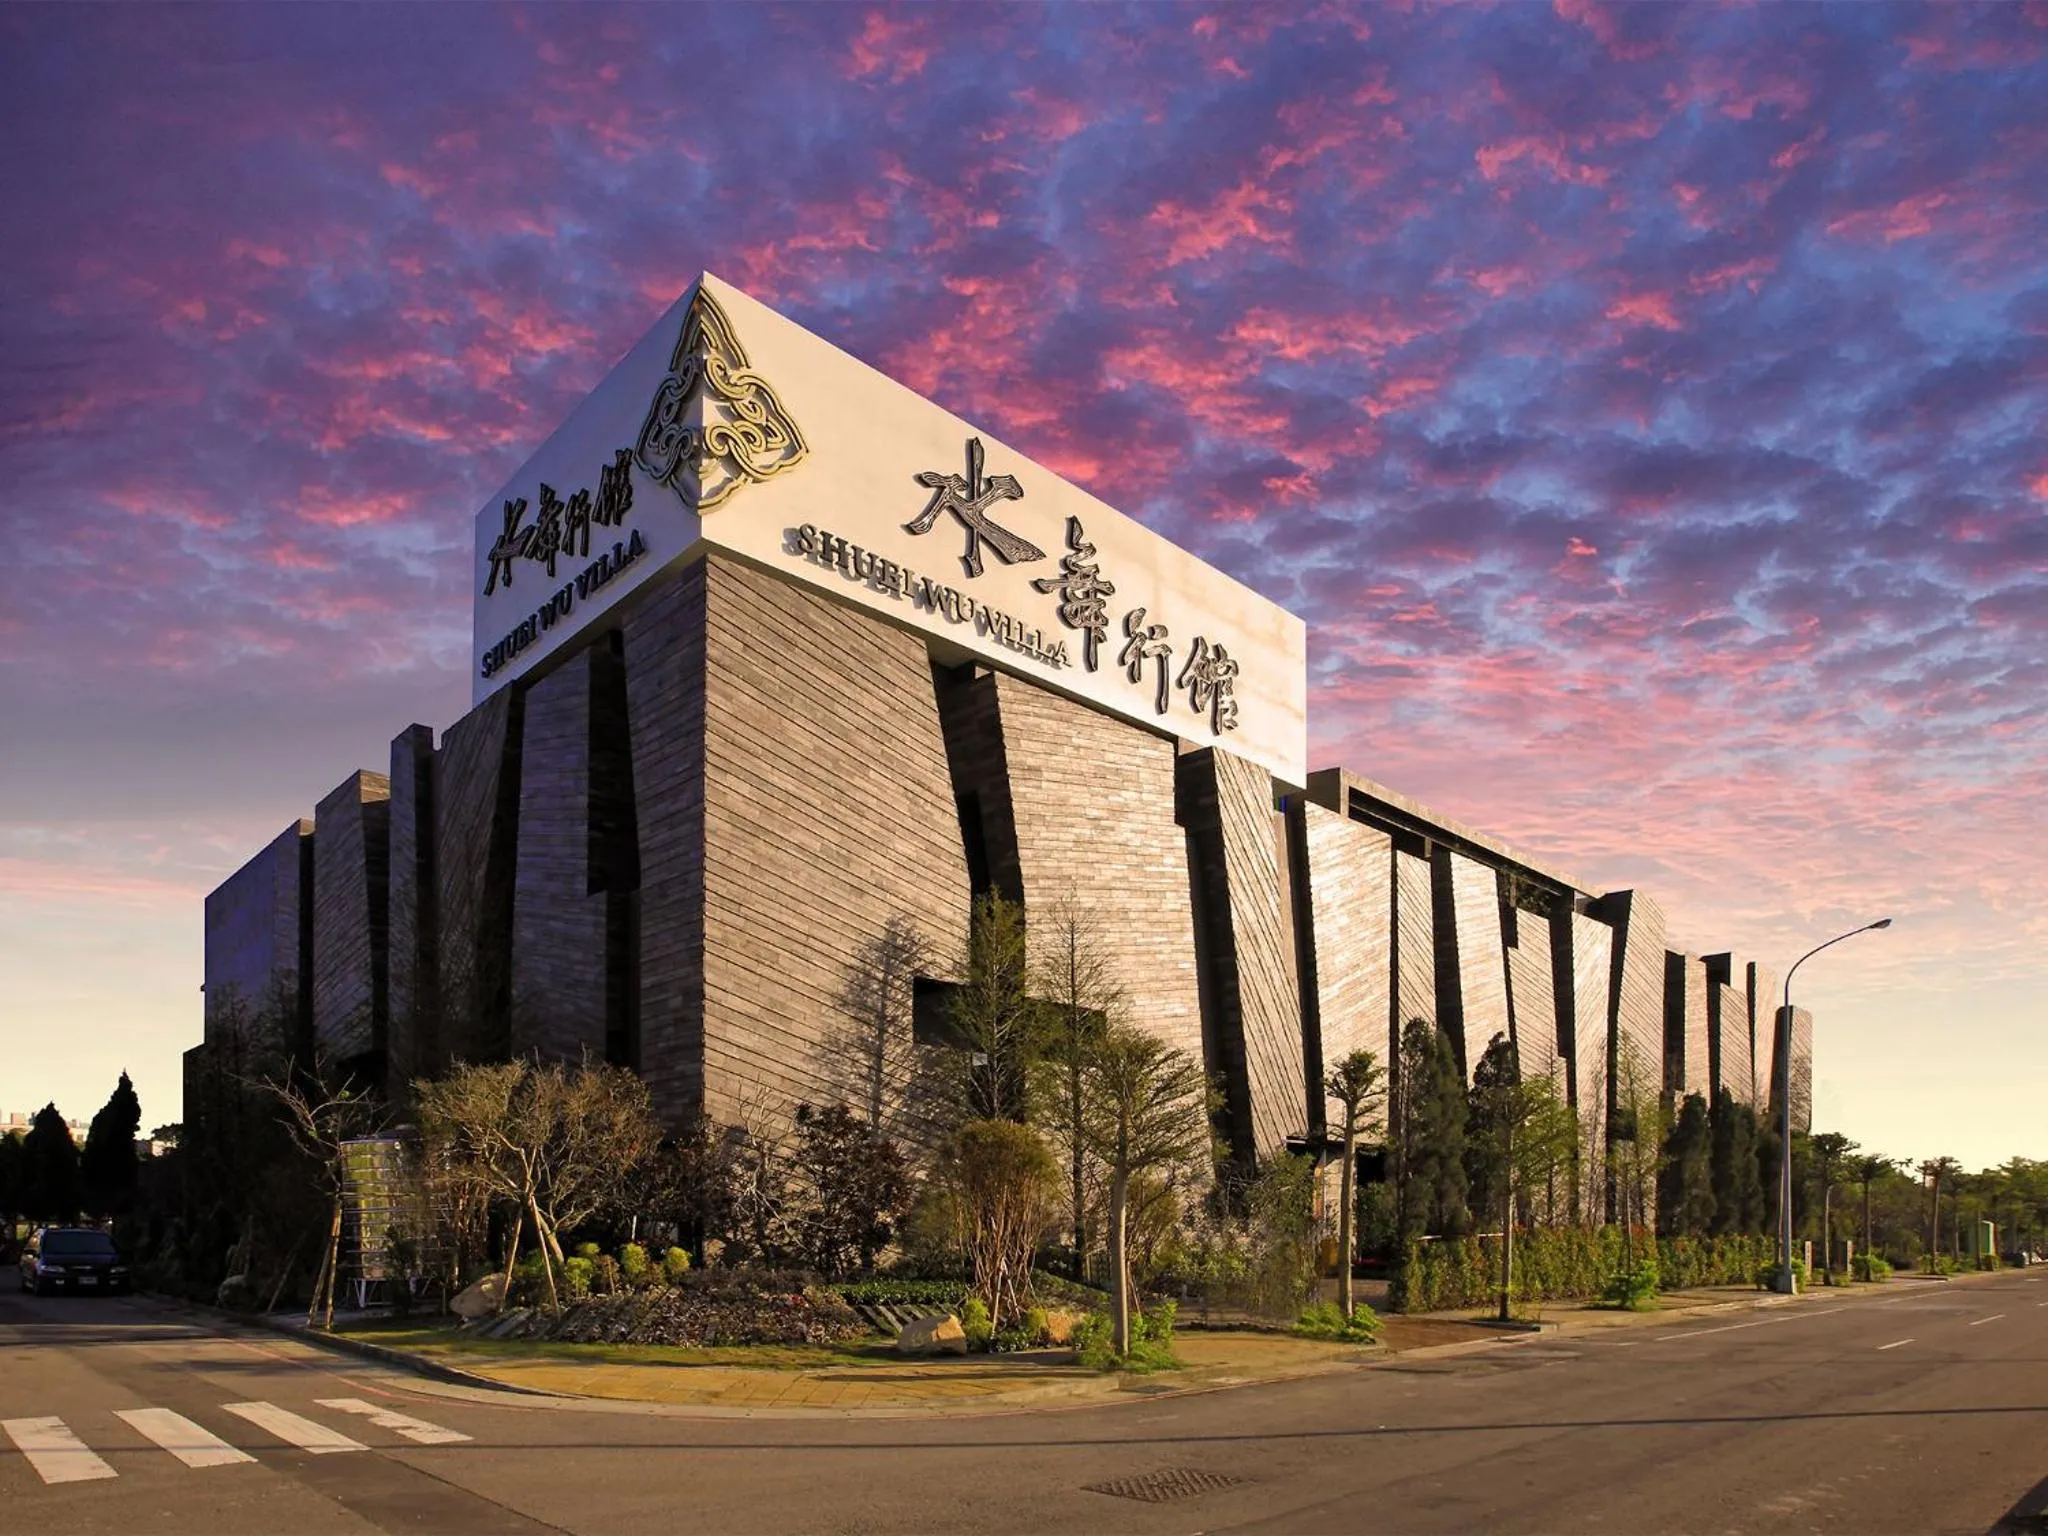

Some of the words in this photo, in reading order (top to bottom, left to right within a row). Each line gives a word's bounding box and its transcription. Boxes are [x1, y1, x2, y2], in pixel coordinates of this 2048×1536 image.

[538, 583, 574, 631] WU
[574, 529, 646, 600] VILLA
[798, 523, 916, 599] SHUEI
[920, 576, 975, 622] WU
[983, 605, 1073, 668] VILLA
